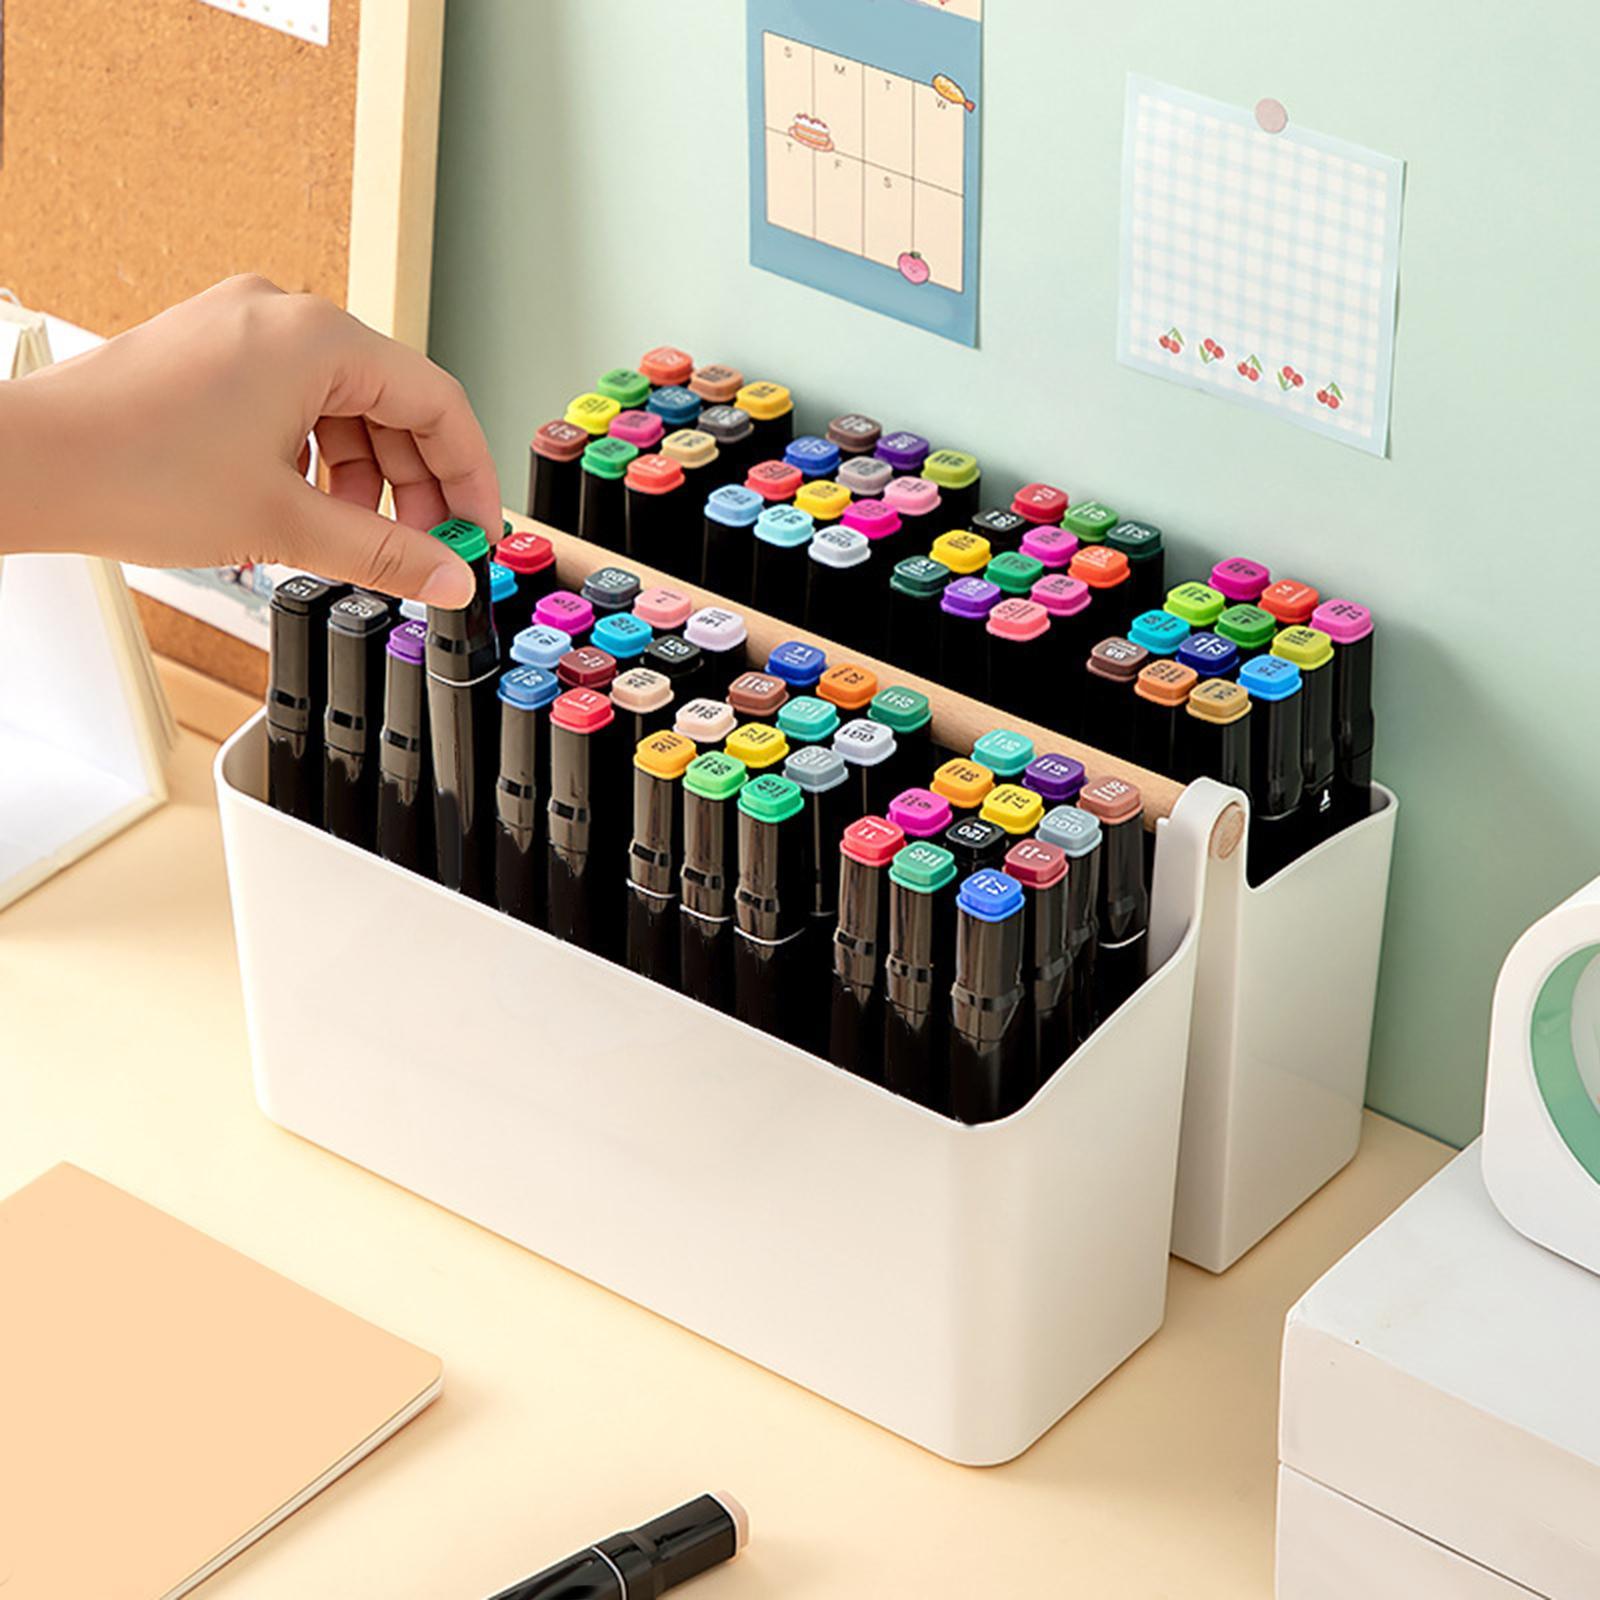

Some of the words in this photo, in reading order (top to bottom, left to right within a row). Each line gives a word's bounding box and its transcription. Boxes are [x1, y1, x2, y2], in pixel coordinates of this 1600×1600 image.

[784, 46, 792, 58] S
[834, 64, 845, 75] M
[884, 79, 892, 90] T
[936, 98, 947, 110] W
[786, 142, 793, 152] T
[834, 159, 842, 169] F
[883, 176, 892, 188] S
[282, 581, 311, 597] 120
[662, 639, 689, 654] 120
[1207, 643, 1227, 654] 72
[844, 673, 864, 684] 23
[578, 693, 597, 703] 11
[1010, 796, 1031, 808] 37
[857, 827, 878, 839] 11
[956, 824, 986, 840] 120
[1037, 852, 1052, 860] 1
[985, 881, 1008, 894] 71
